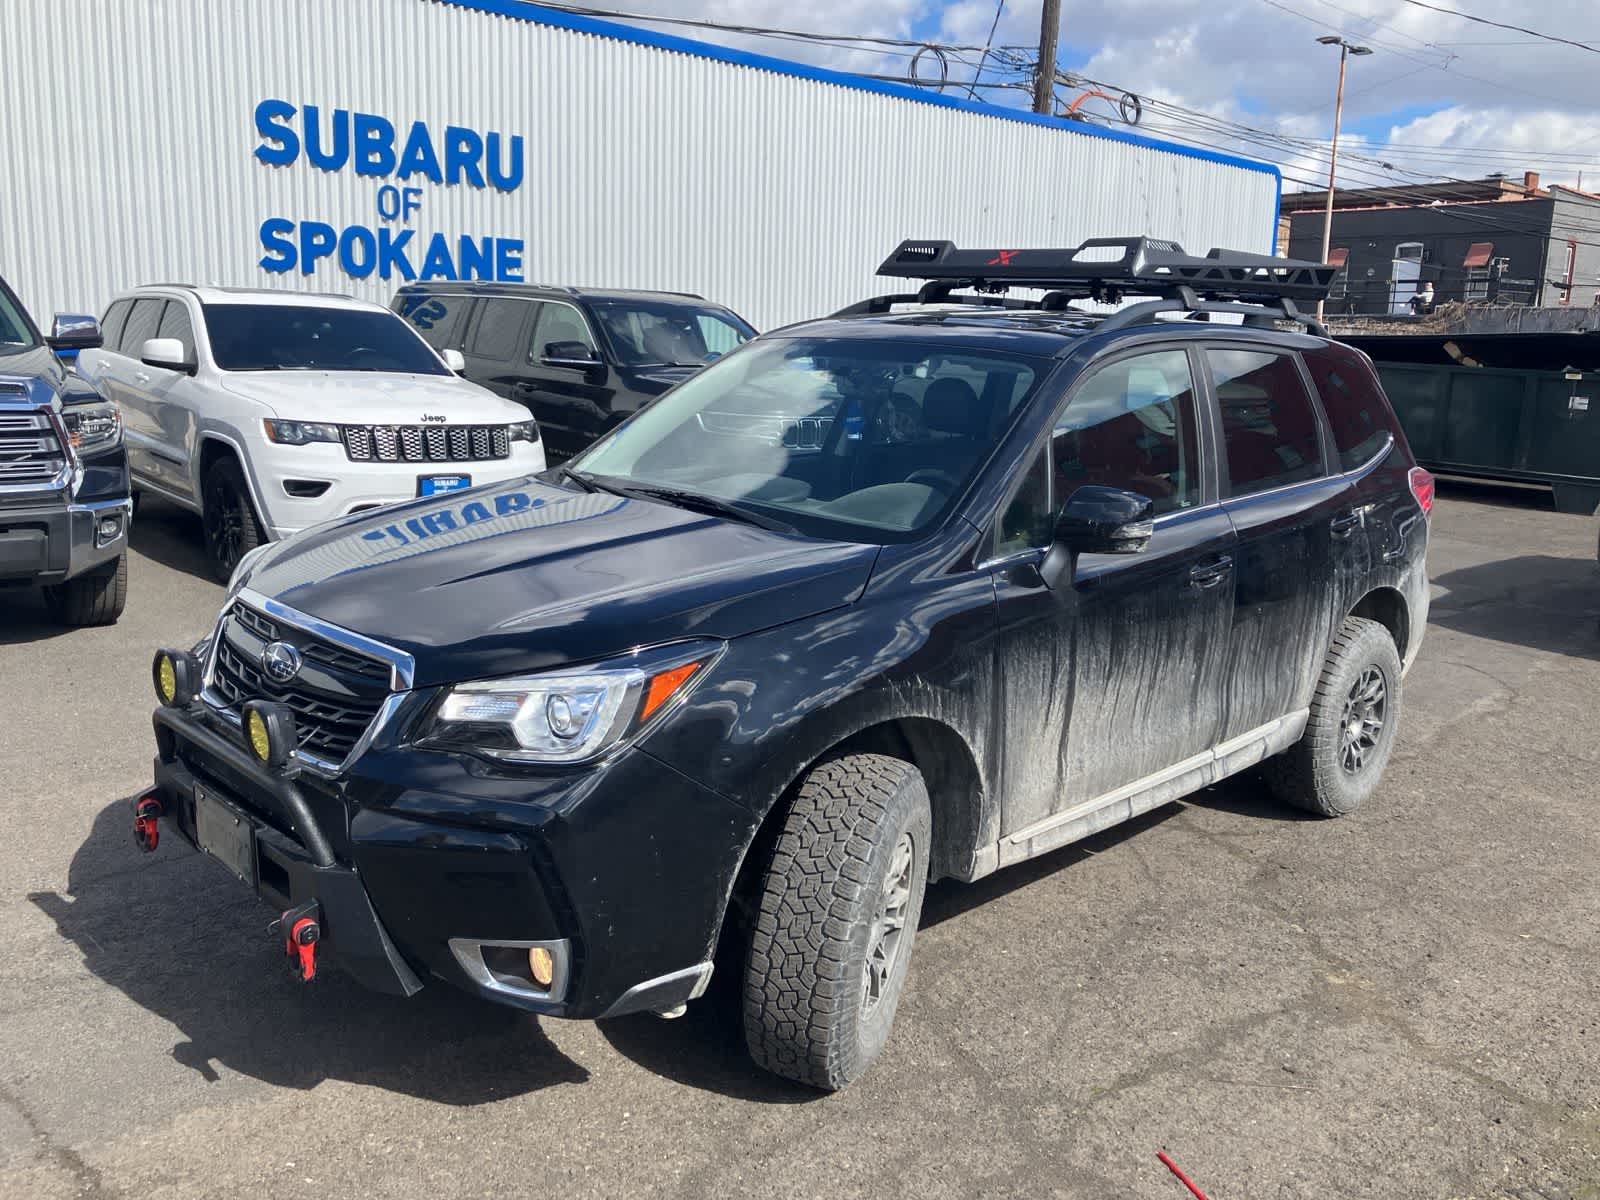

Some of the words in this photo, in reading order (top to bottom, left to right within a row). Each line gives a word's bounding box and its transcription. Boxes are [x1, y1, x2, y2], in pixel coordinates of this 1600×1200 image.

[254, 99, 524, 192] SUBARU
[376, 185, 423, 221] OF
[258, 217, 524, 282] SPOKANE
[420, 413, 447, 424] Jeep
